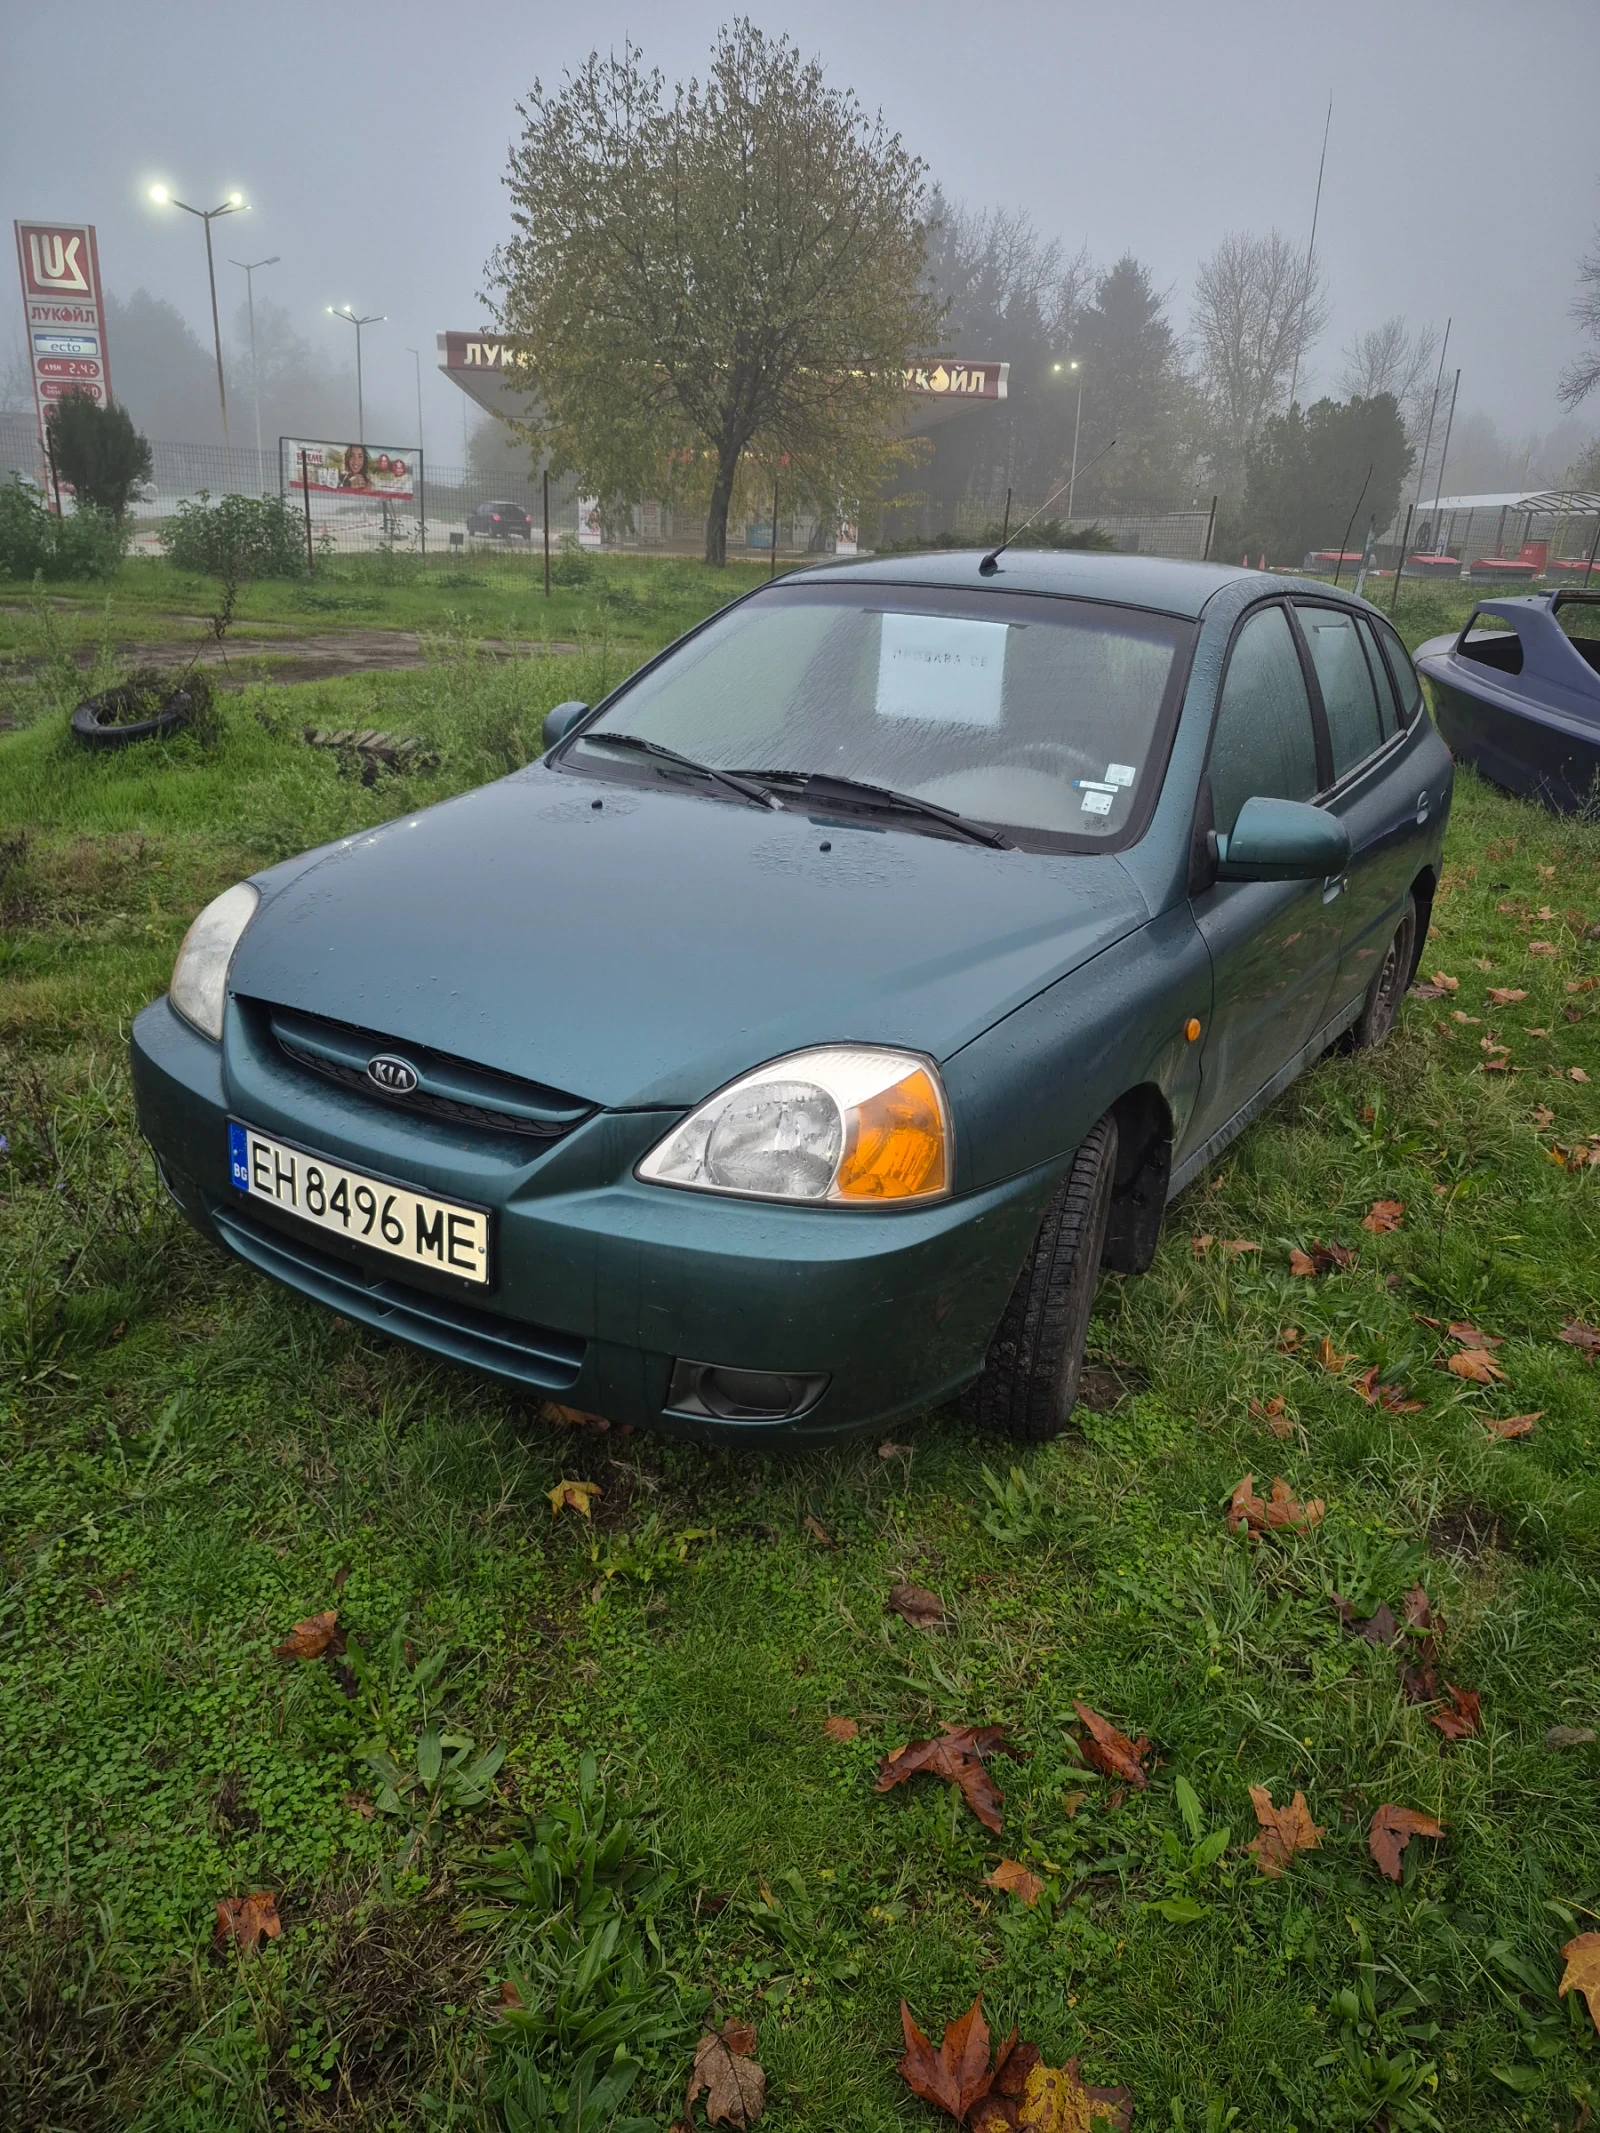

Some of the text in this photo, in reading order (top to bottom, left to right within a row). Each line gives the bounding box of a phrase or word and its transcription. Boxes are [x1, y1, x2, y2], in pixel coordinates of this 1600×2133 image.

[31, 306, 96, 323] ЛУКОЙЛ
[50, 343, 81, 352] ecto
[69, 362, 96, 375] 2.42
[375, 1061, 409, 1088] KIA
[233, 1162, 248, 1182] BG
[306, 1166, 406, 1246] 8496
[416, 1203, 478, 1272] ME
